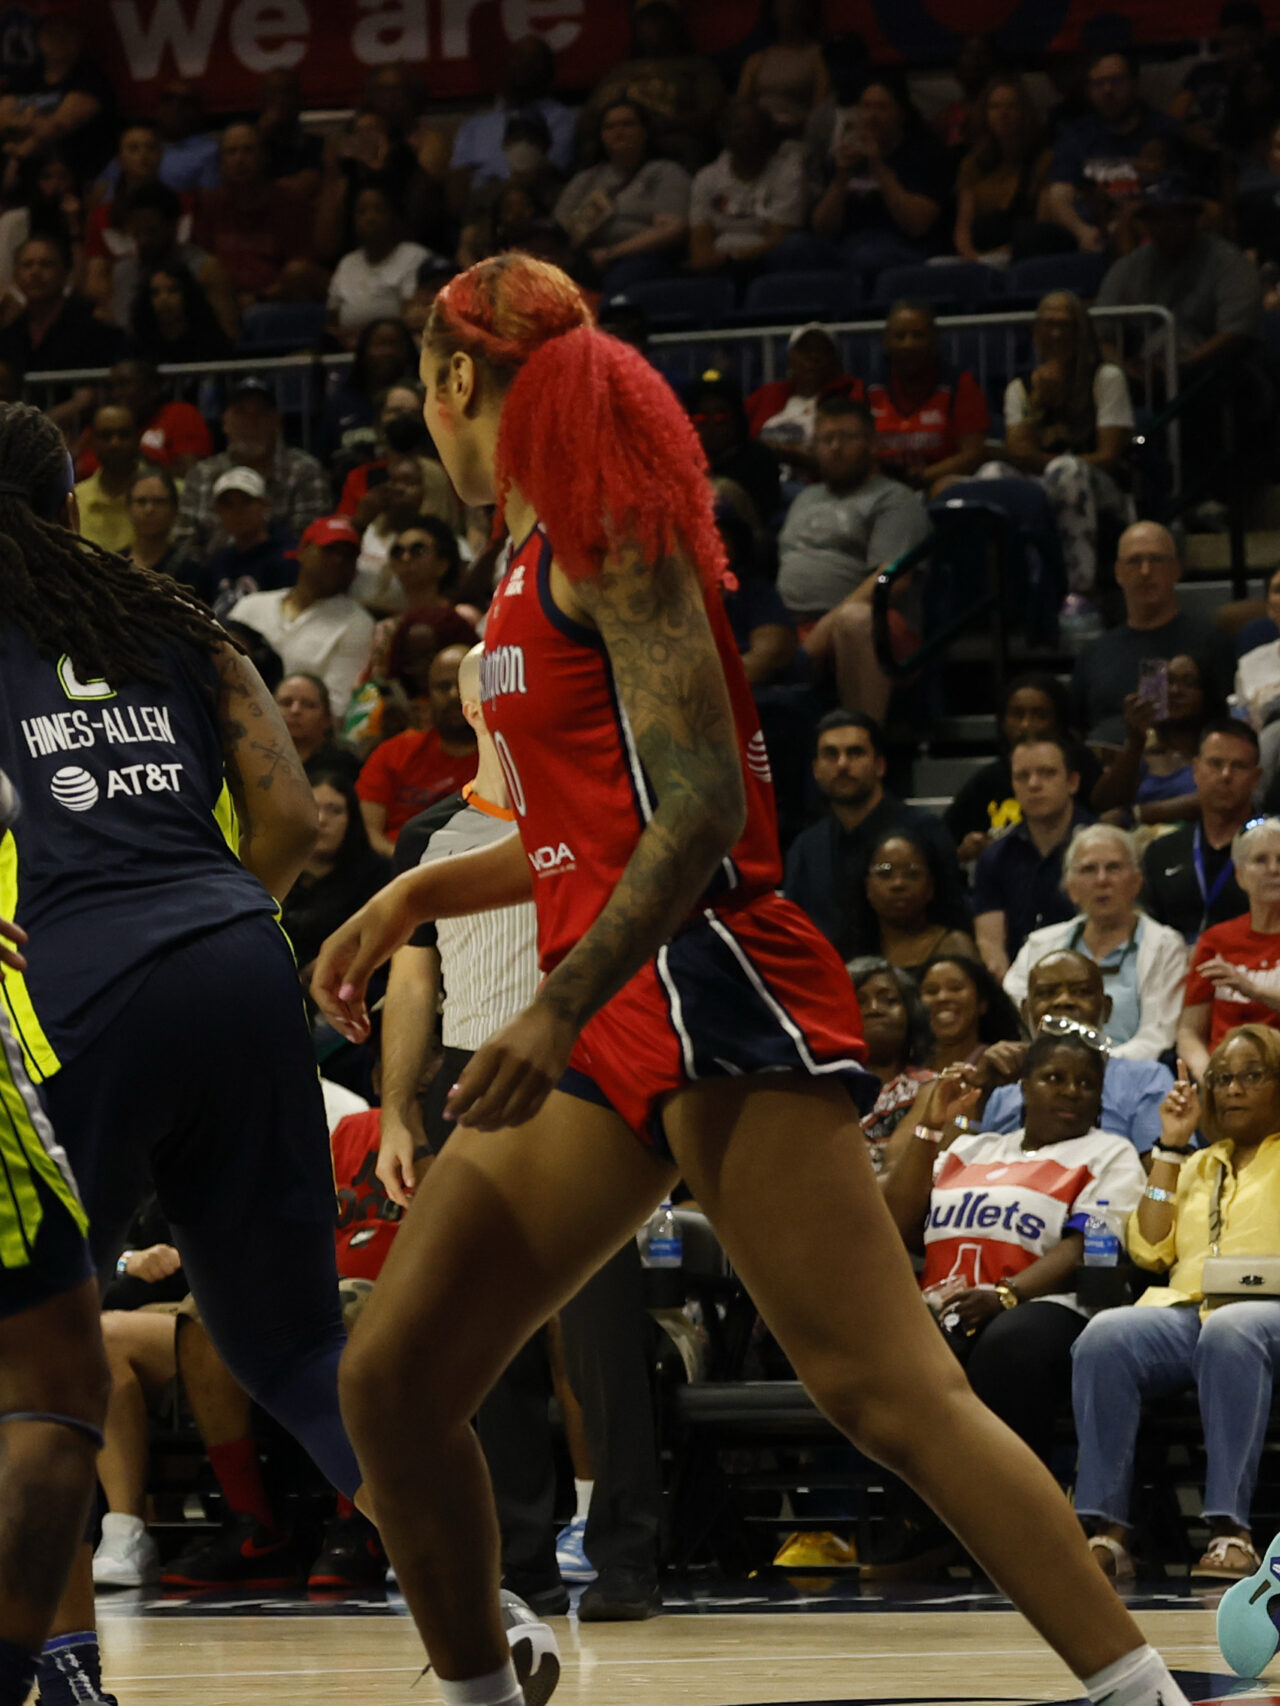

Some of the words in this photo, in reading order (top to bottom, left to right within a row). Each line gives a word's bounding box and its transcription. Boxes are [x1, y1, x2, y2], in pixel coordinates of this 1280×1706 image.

[21, 705, 176, 758] HINES-ALLEN
[107, 763, 183, 799] AT&T
[924, 1192, 1046, 1240] ullets
